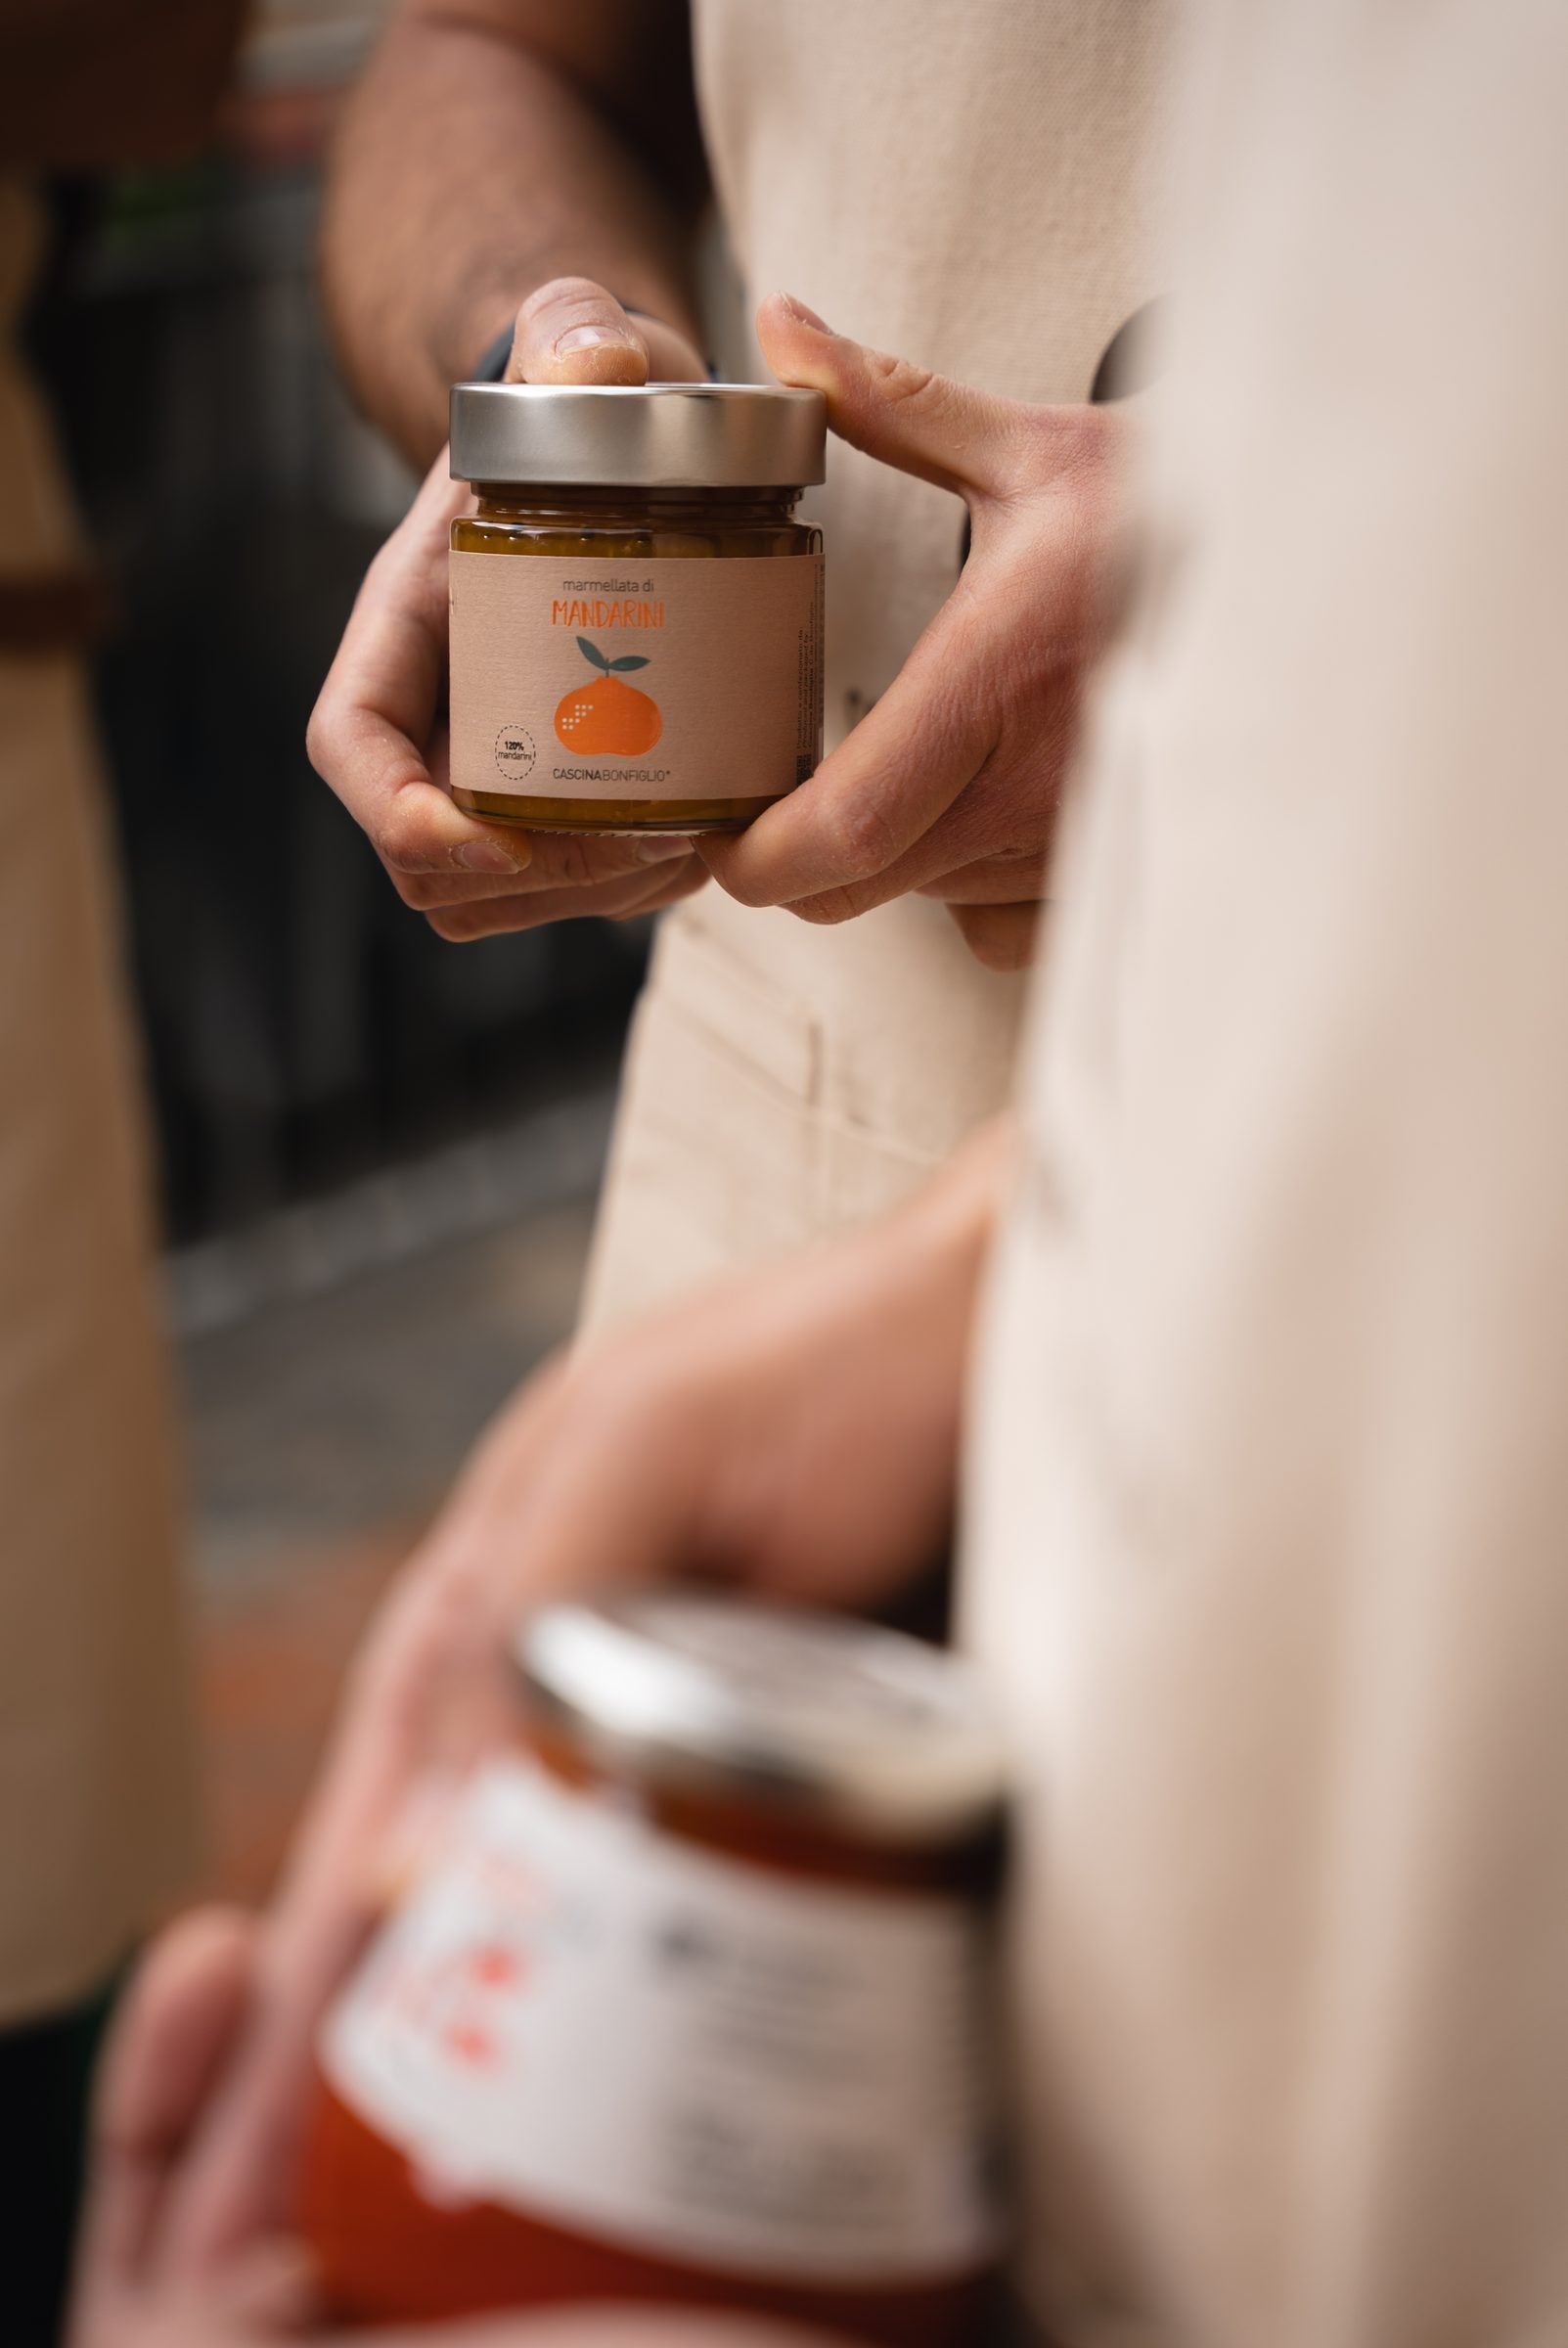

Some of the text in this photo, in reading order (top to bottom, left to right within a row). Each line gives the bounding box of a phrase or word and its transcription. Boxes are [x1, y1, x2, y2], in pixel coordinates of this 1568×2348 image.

[563, 578, 654, 592] marmellata di
[552, 599, 665, 628] MANDARINI
[505, 742, 524, 751] 120%
[498, 750, 532, 761] mandarini
